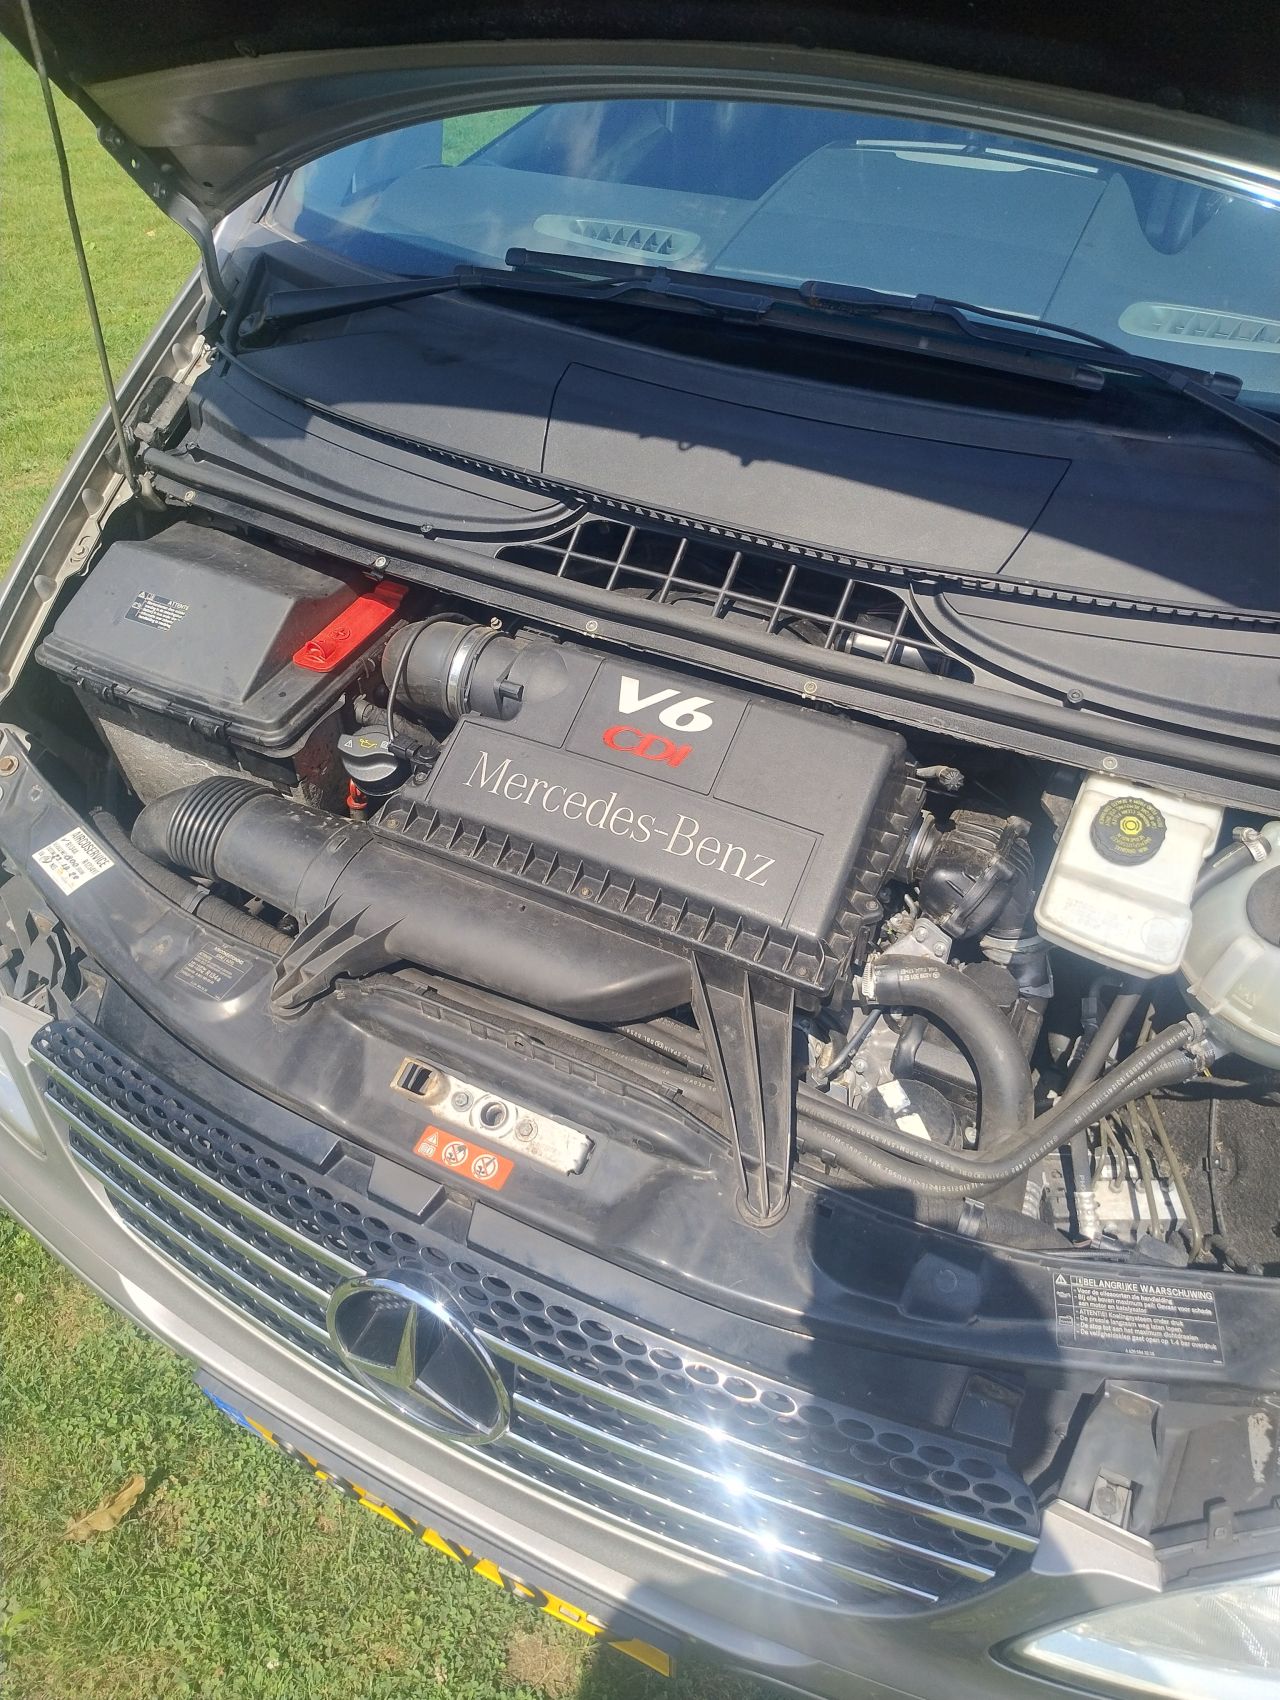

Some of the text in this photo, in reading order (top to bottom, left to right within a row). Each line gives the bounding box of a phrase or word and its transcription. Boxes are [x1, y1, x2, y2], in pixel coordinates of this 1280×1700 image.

[618, 676, 714, 733] V6
[602, 724, 694, 769] CDI
[462, 750, 776, 887] Mercedes-Benz
[72, 831, 109, 867] AIRCOSERVICE
[1082, 1278, 1137, 1291] BELANGRIJKE
